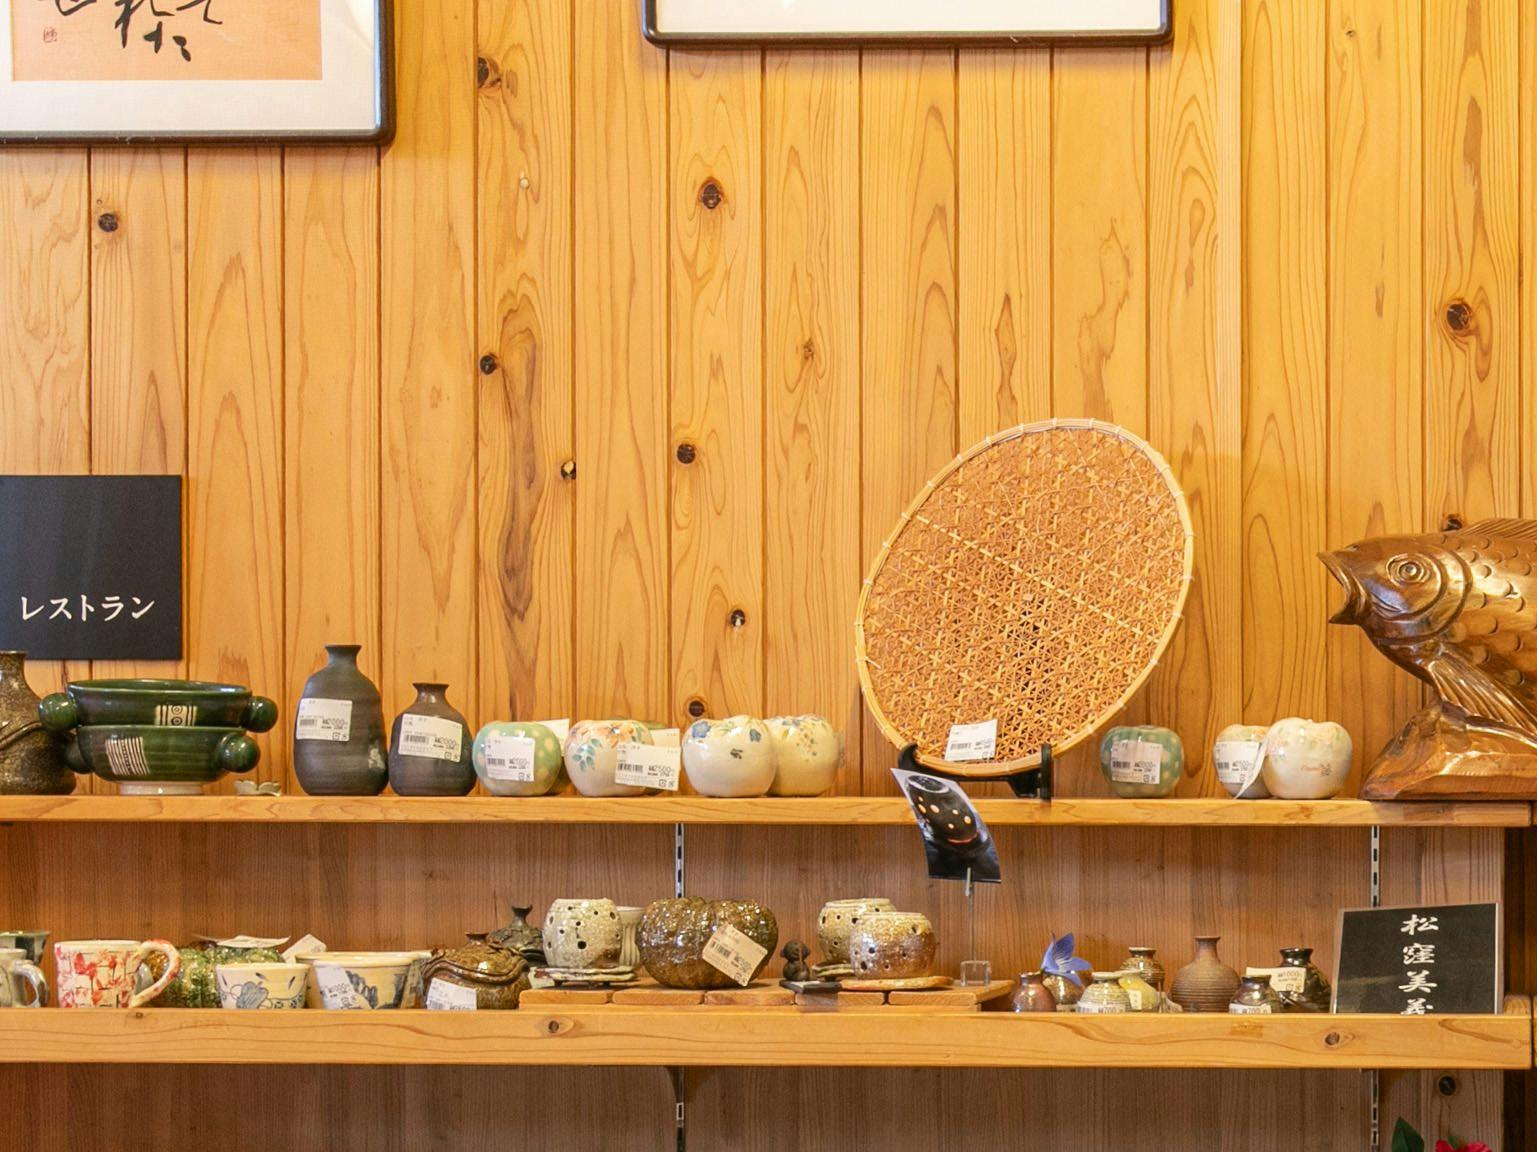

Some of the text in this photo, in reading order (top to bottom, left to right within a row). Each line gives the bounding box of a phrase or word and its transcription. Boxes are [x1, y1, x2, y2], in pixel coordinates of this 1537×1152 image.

[20, 594, 156, 622] レストラン
